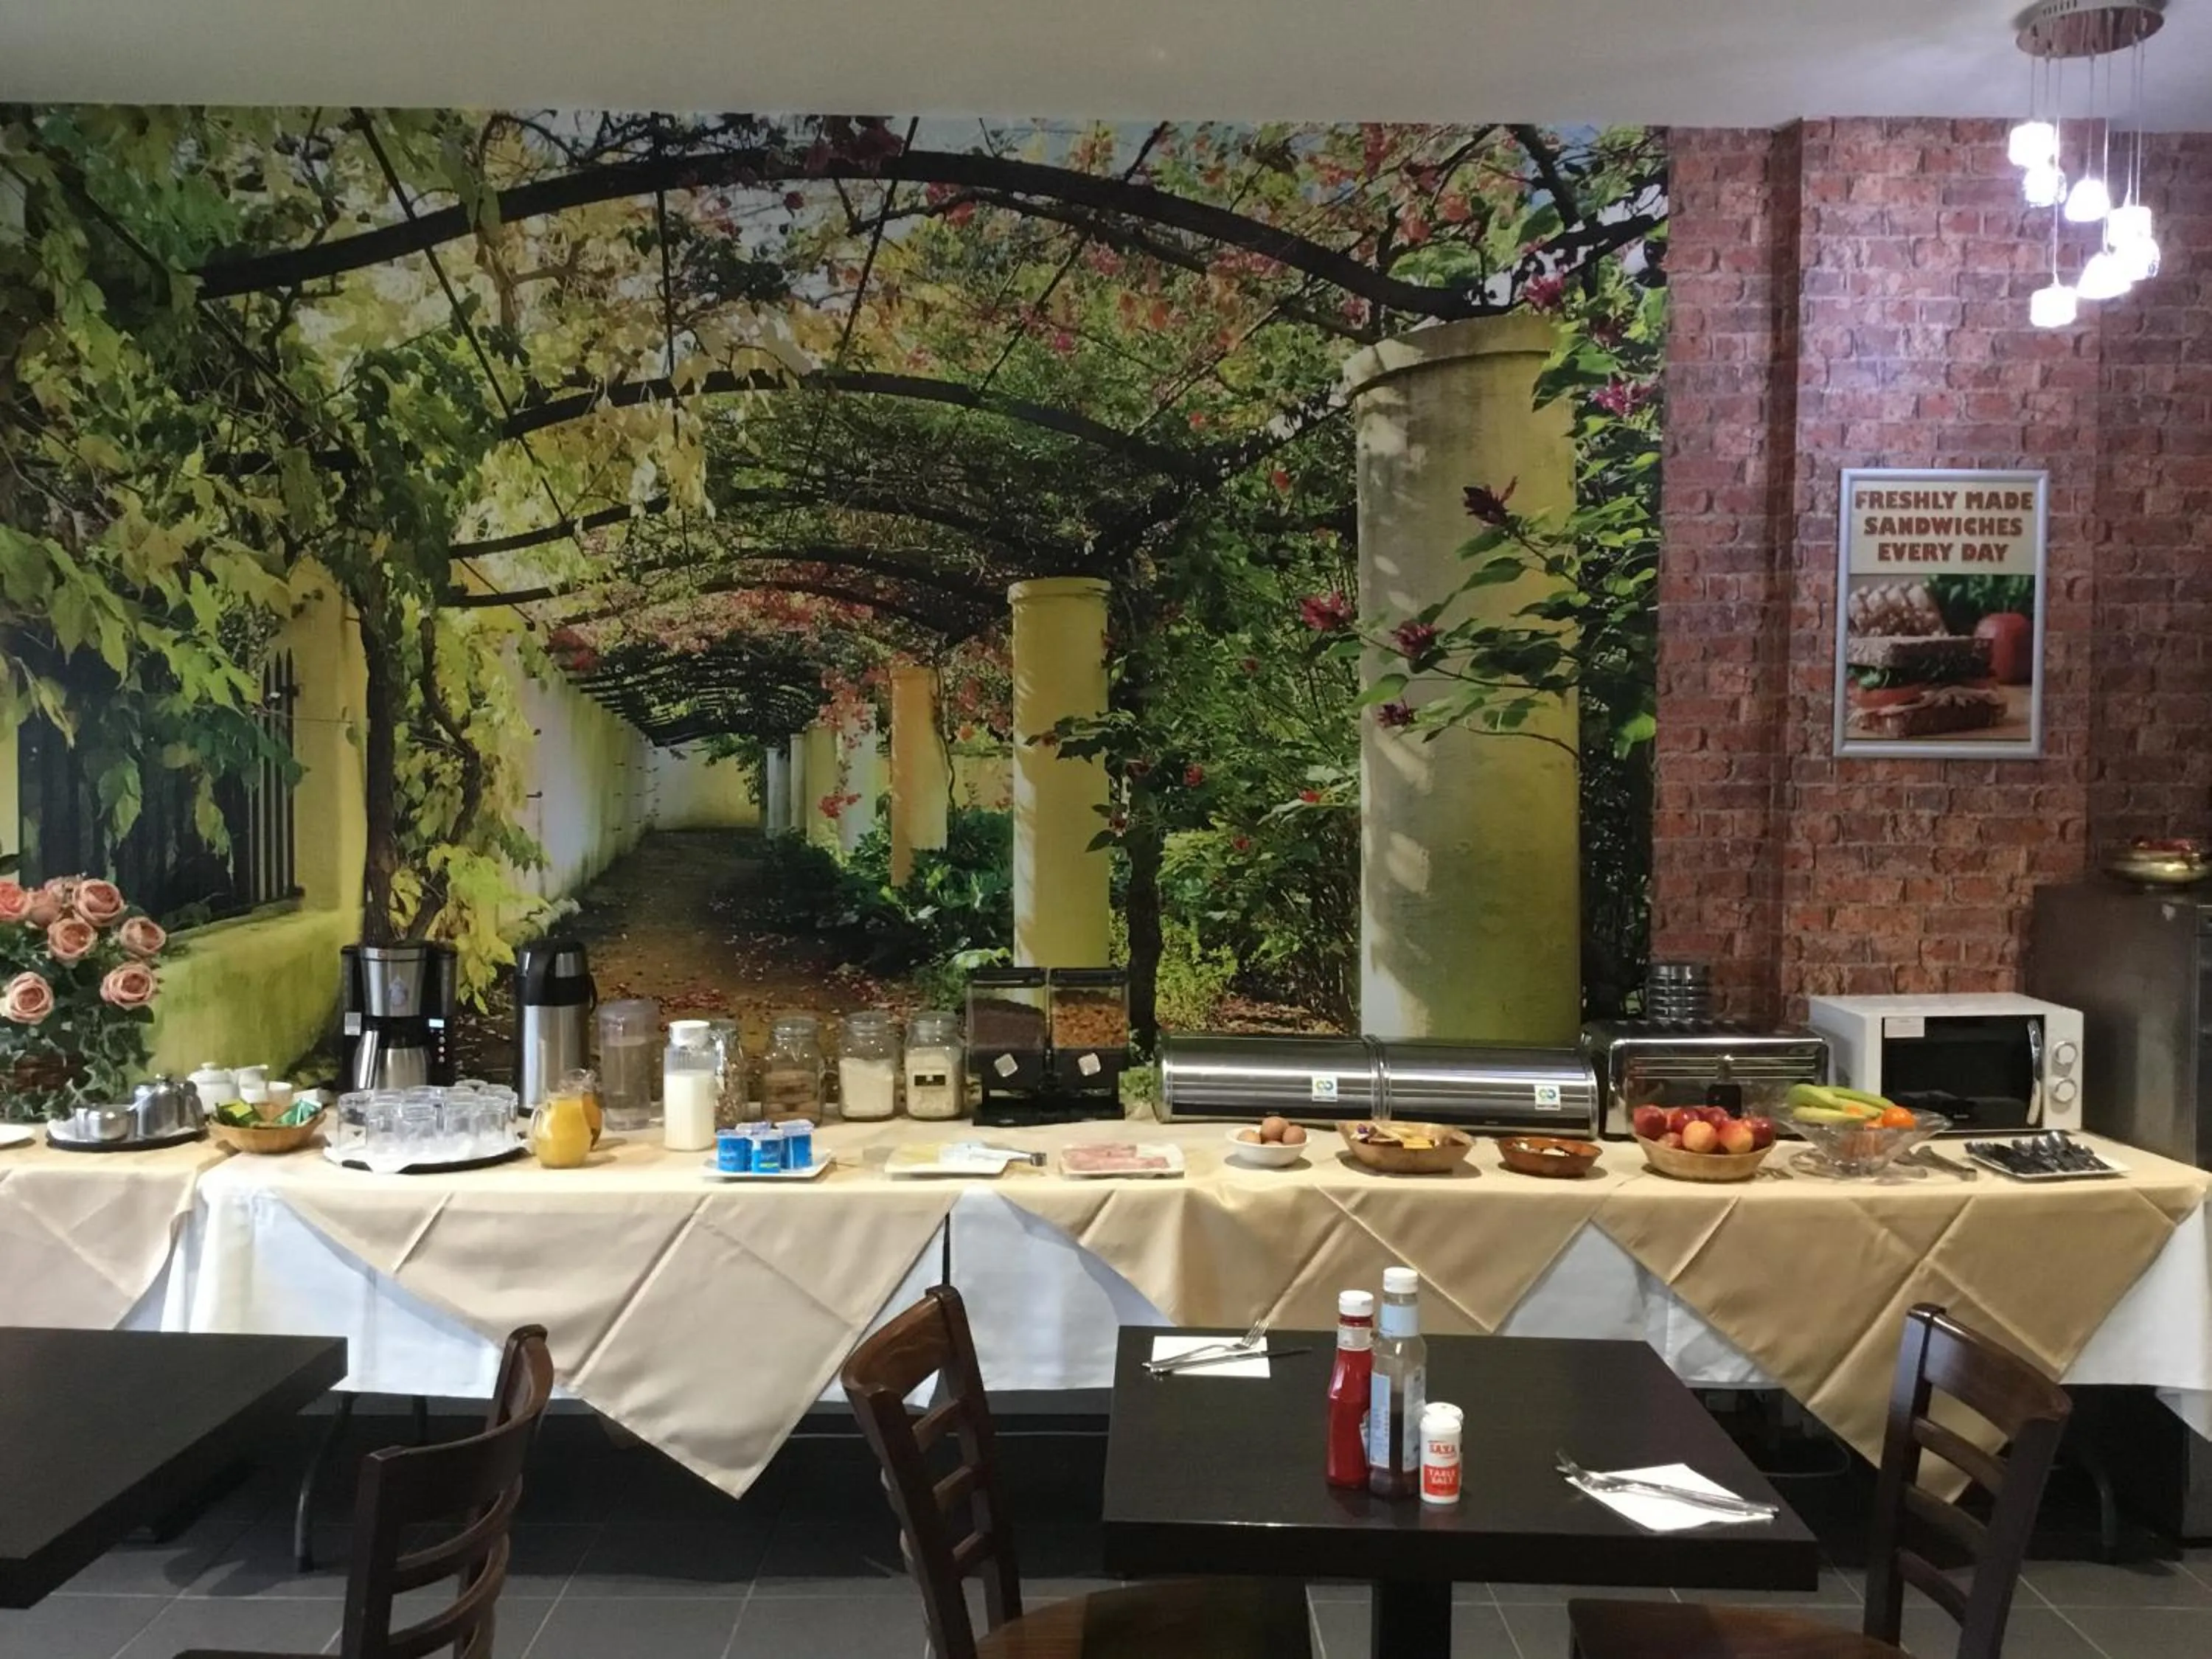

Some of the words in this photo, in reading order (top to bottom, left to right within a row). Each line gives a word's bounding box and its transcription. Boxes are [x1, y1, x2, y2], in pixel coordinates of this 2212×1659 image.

[1854, 491, 1958, 509] FRESHLY
[1965, 492, 2034, 510] MADE
[1864, 517, 2023, 536] SANDWICHES
[1878, 543, 1954, 561] EVERY
[1961, 543, 2009, 561] DAY
